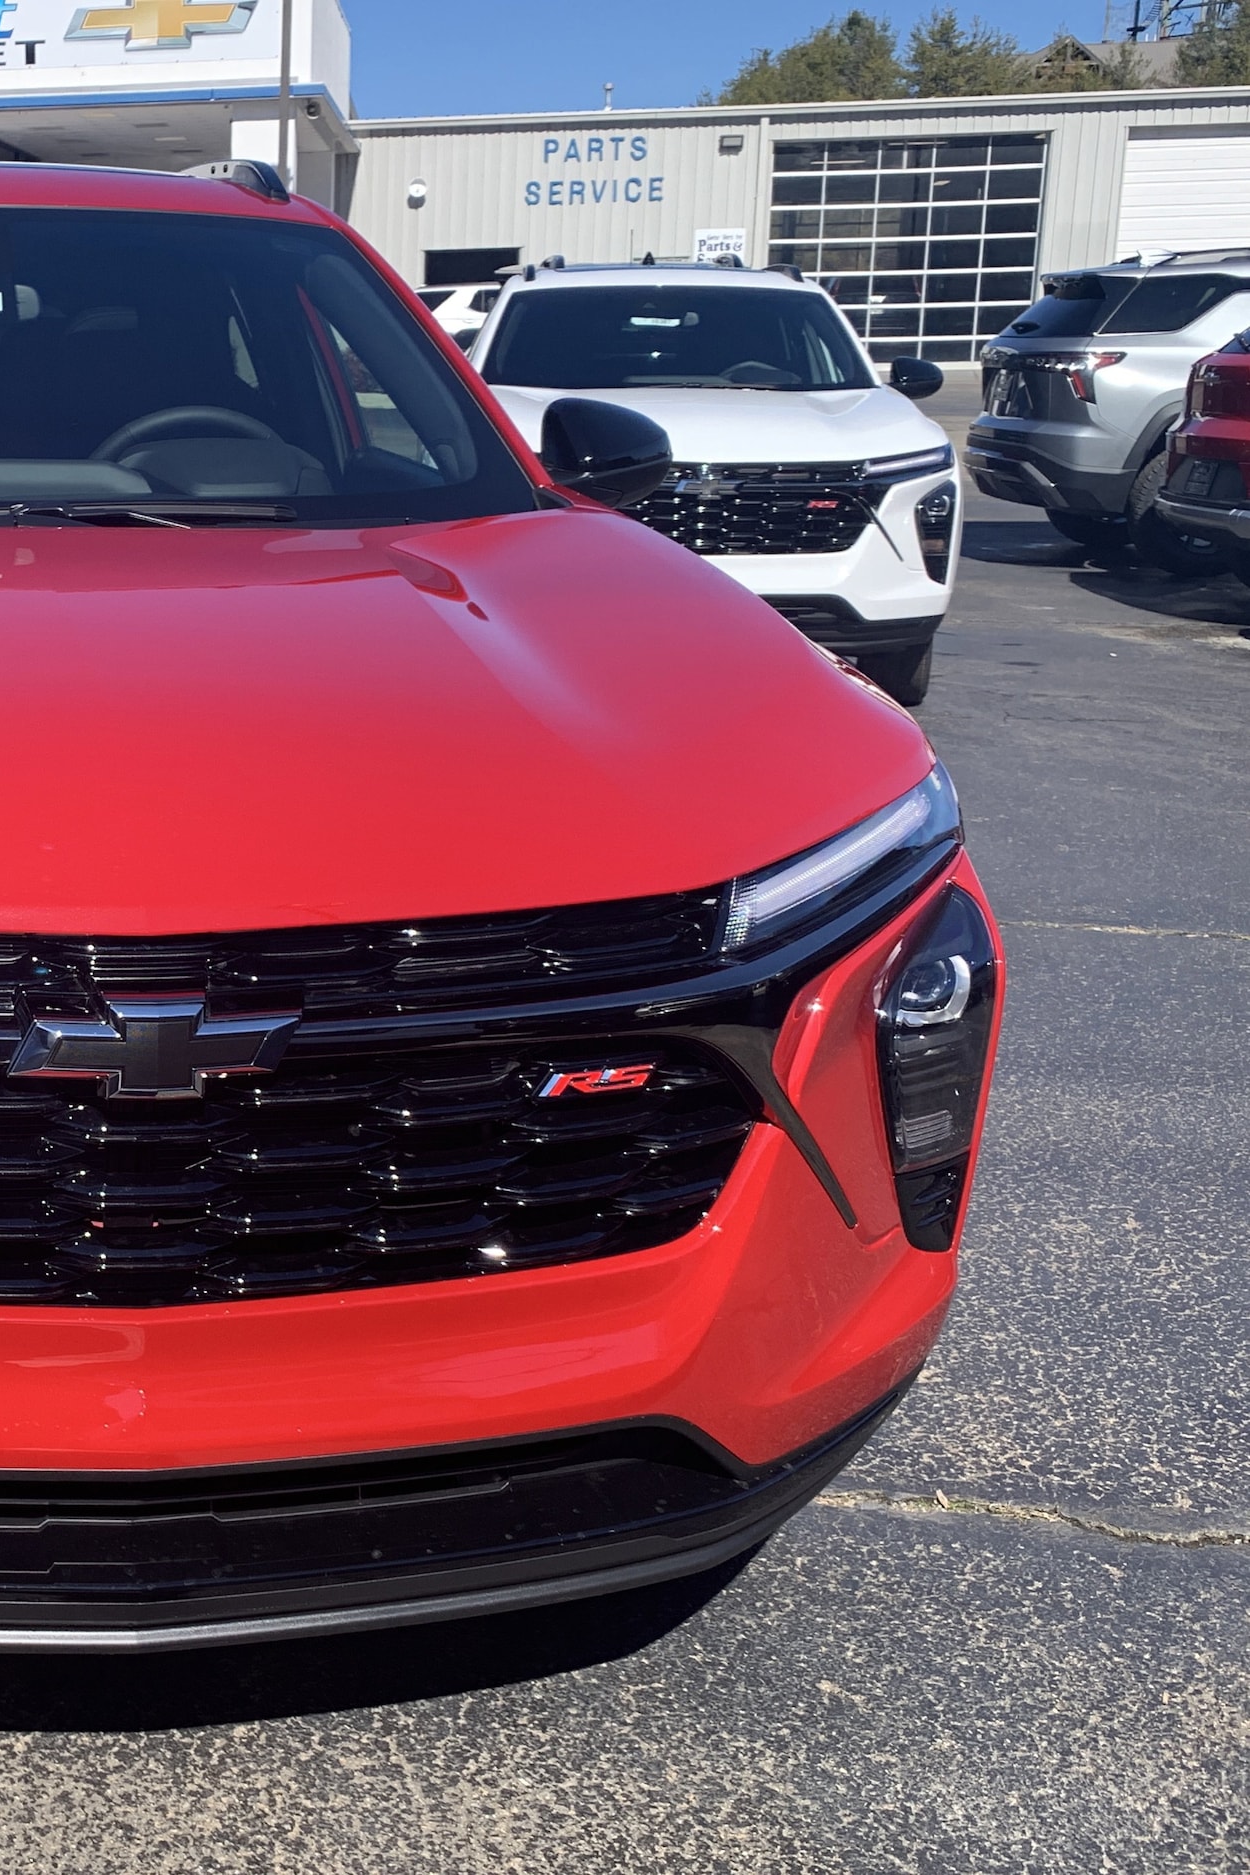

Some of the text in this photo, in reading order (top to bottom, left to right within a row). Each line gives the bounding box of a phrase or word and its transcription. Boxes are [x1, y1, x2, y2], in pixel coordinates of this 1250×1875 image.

[543, 136, 648, 163] PARTS
[524, 177, 665, 206] SERVICE
[697, 239, 743, 252] Parts &
[538, 1064, 654, 1097] RS
